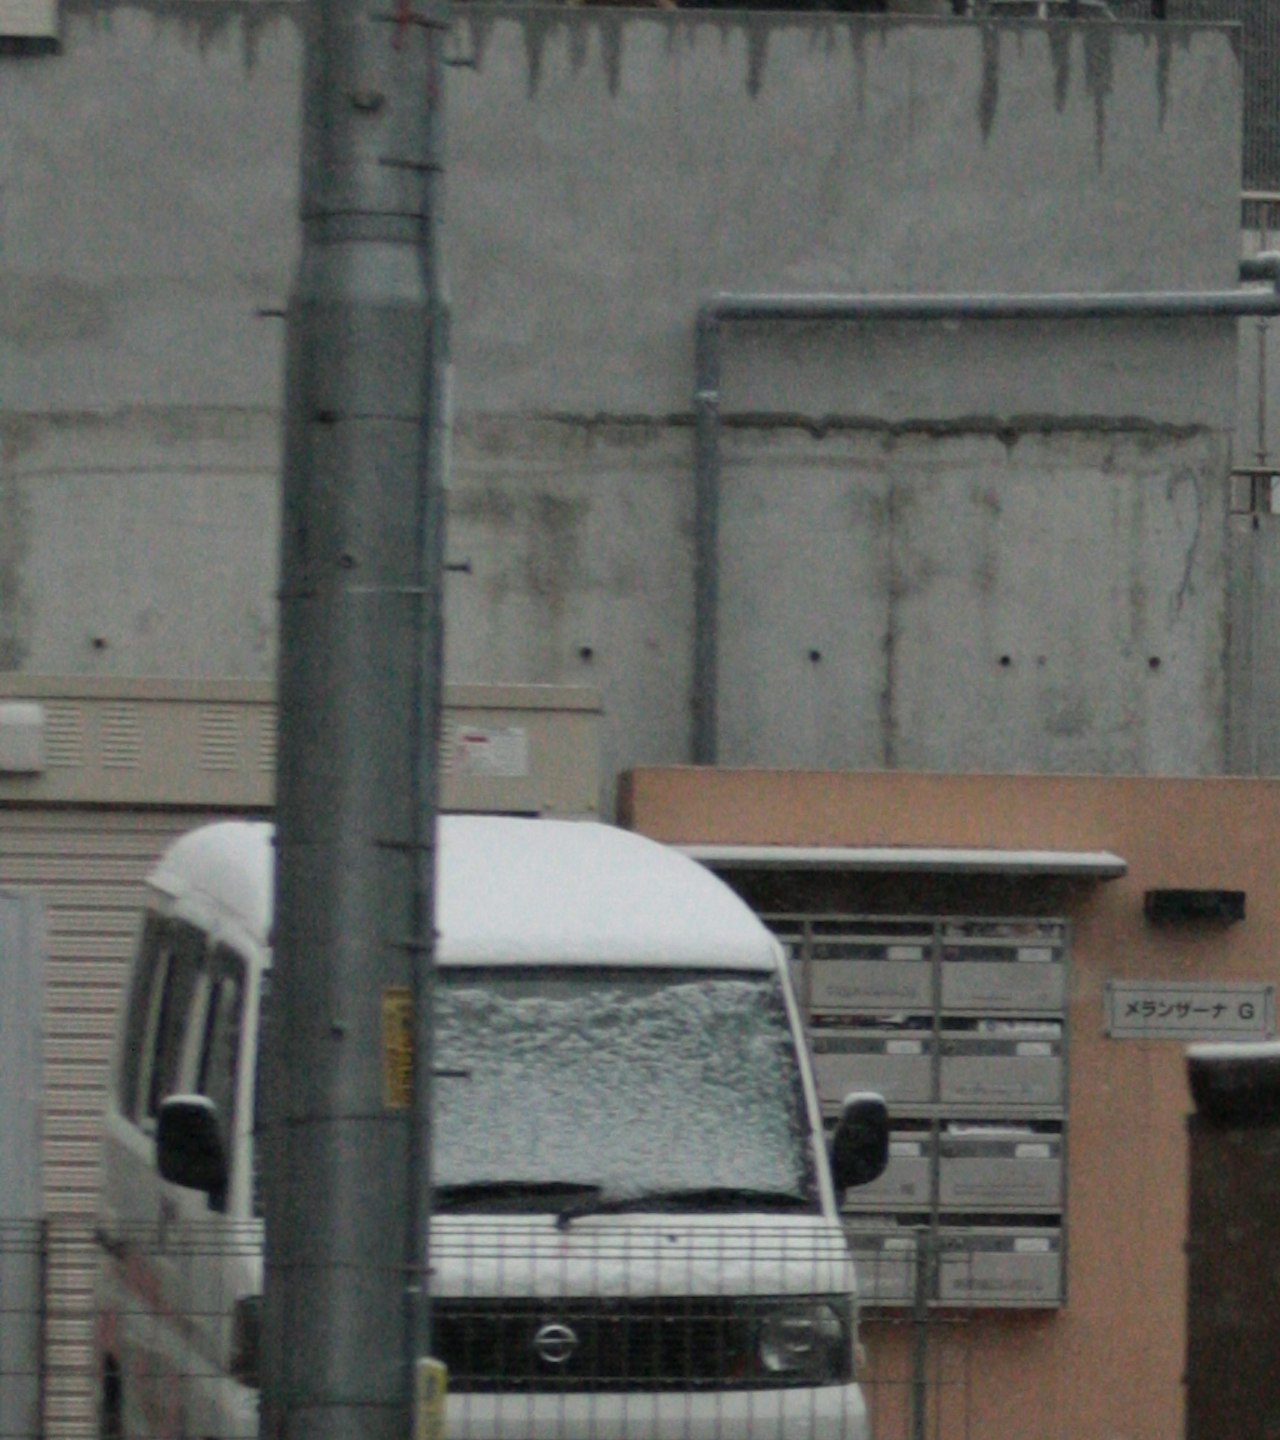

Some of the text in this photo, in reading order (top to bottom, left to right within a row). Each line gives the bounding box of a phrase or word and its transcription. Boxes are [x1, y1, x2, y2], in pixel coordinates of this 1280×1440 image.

[1124, 1000, 1256, 1020] メランザーナ G
